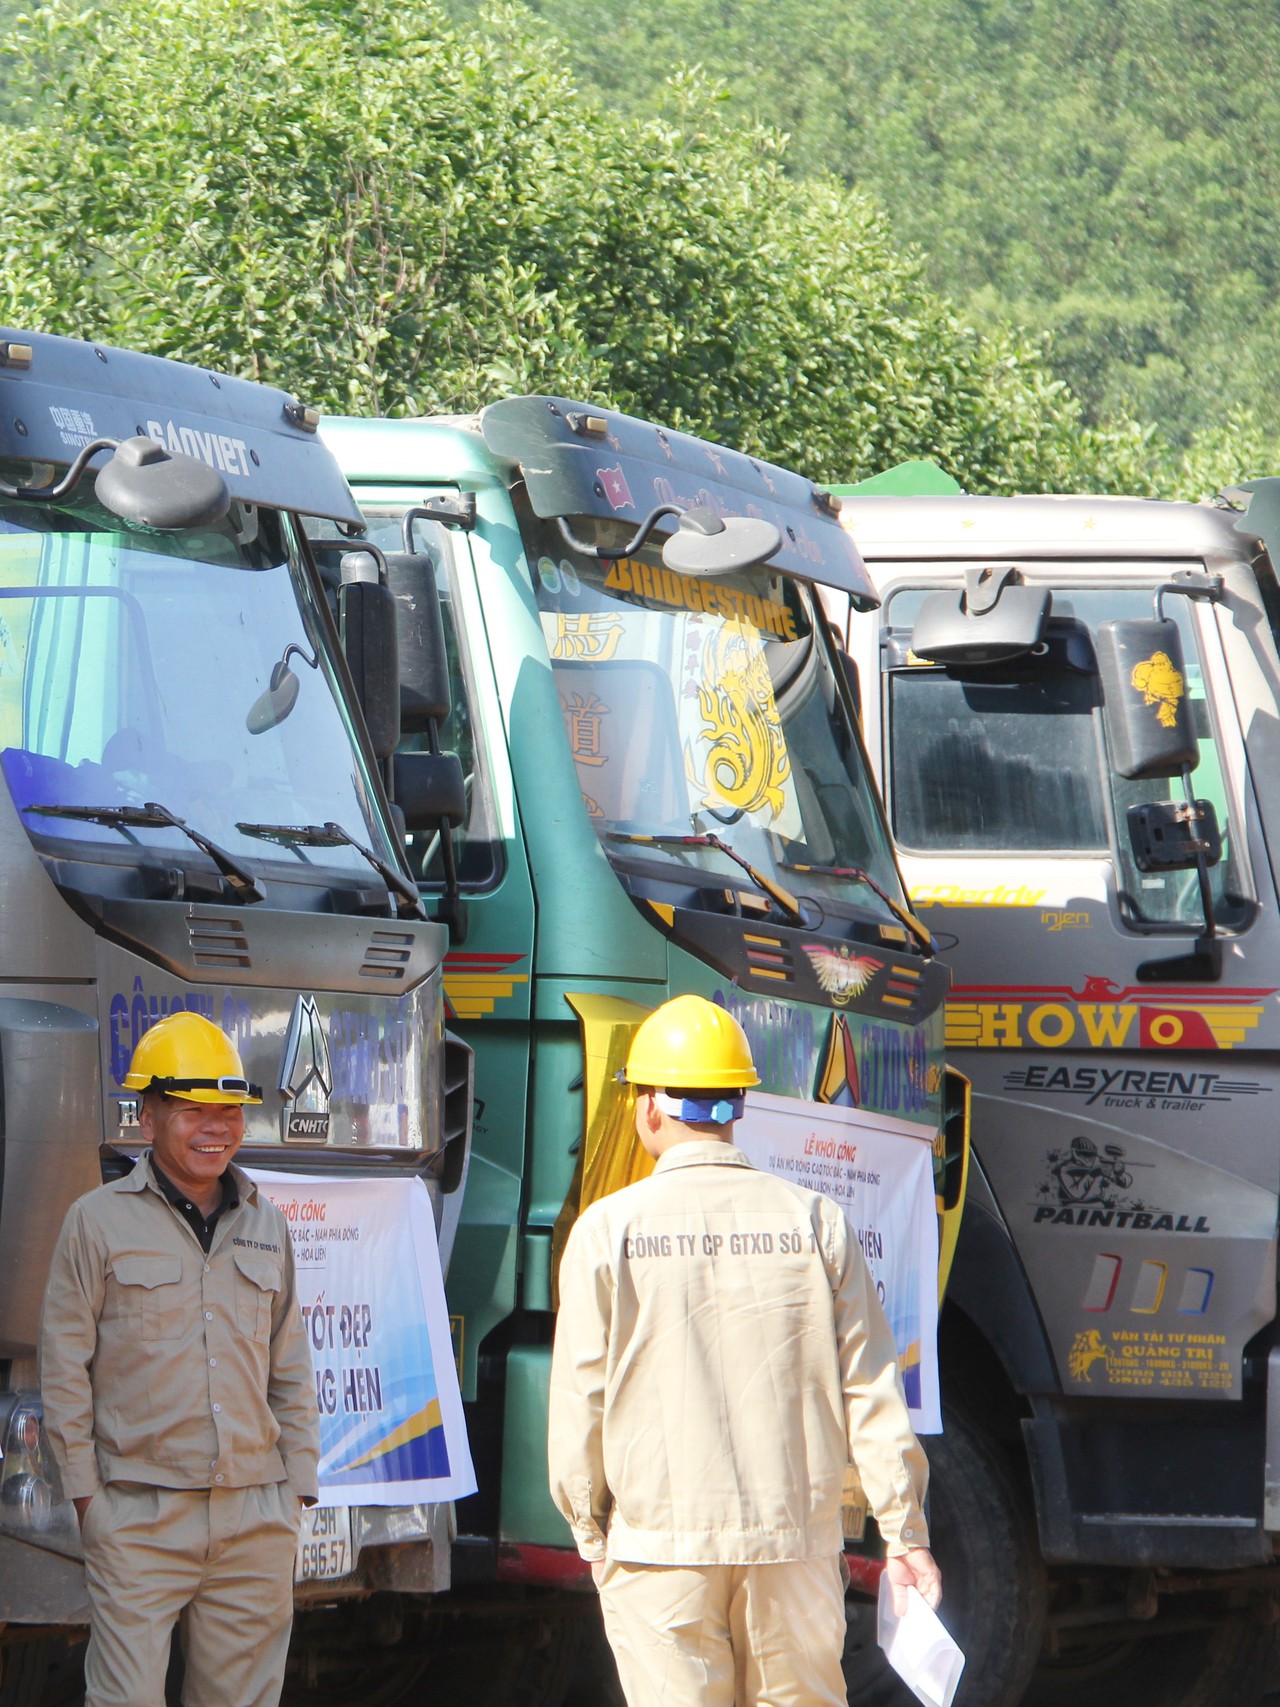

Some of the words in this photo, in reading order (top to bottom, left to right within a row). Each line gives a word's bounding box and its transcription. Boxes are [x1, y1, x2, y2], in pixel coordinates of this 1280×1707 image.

[604, 559, 799, 640] BRIDGESTONE
[977, 1003, 1184, 1047] HOWO
[1024, 1065, 1221, 1106] EASYRENT
[1104, 1096, 1144, 1109] truck
[1146, 1097, 1157, 1109] &
[1160, 1098, 1207, 1112] trailer
[289, 1118, 329, 1133] CNHTC
[804, 1133, 815, 1155] LỄ
[815, 1138, 836, 1158] KHỞI
[837, 1141, 856, 1162] CÔNG
[301, 1199, 326, 1221] CÔNG
[1033, 1207, 1211, 1233] PAINTBALL
[315, 1228, 328, 1242] NAM
[624, 1232, 671, 1260] CÔNG
[677, 1234, 698, 1257] TY
[702, 1233, 724, 1257] CP
[730, 1231, 774, 1256] GTXD
[780, 1227, 802, 1254] SỐ
[808, 1232, 817, 1255] 1
[340, 1304, 371, 1358] ĐẸP
[342, 1366, 382, 1422] HẸN
[302, 1540, 346, 1578] 696.57
